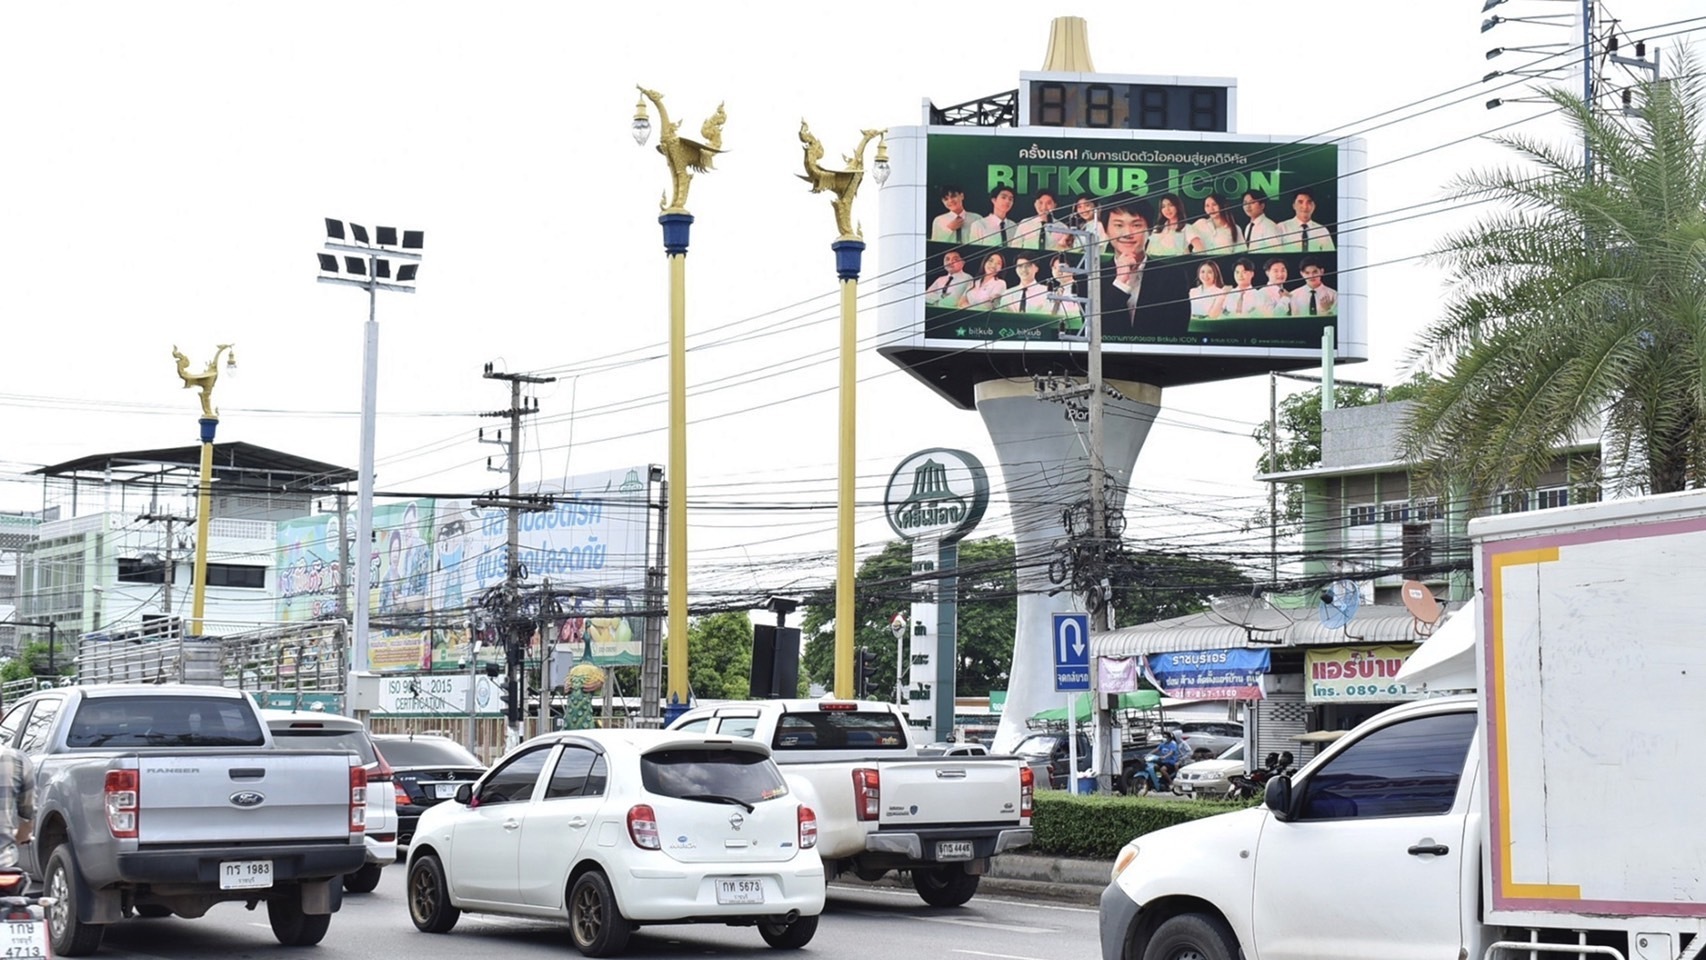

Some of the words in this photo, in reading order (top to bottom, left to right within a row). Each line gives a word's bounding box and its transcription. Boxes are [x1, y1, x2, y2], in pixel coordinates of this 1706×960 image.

[1018, 143, 1078, 160] ครั้งแรก!
[987, 164, 1149, 196] BITKUB
[1168, 168, 1280, 200] ICON
[1312, 649, 1402, 680] แอร์บ้าน
[1057, 671, 1089, 686] จุดกลับรถ
[388, 681, 400, 694] ISO
[431, 680, 453, 693] 2015
[1312, 683, 1340, 697] โทร.
[395, 697, 446, 711] CERTIFICATION
[238, 793, 258, 803] Ford
[226, 864, 241, 876] กร
[246, 863, 270, 875] 1983
[739, 881, 760, 892] 5673
[5, 946, 41, 958] 4713
